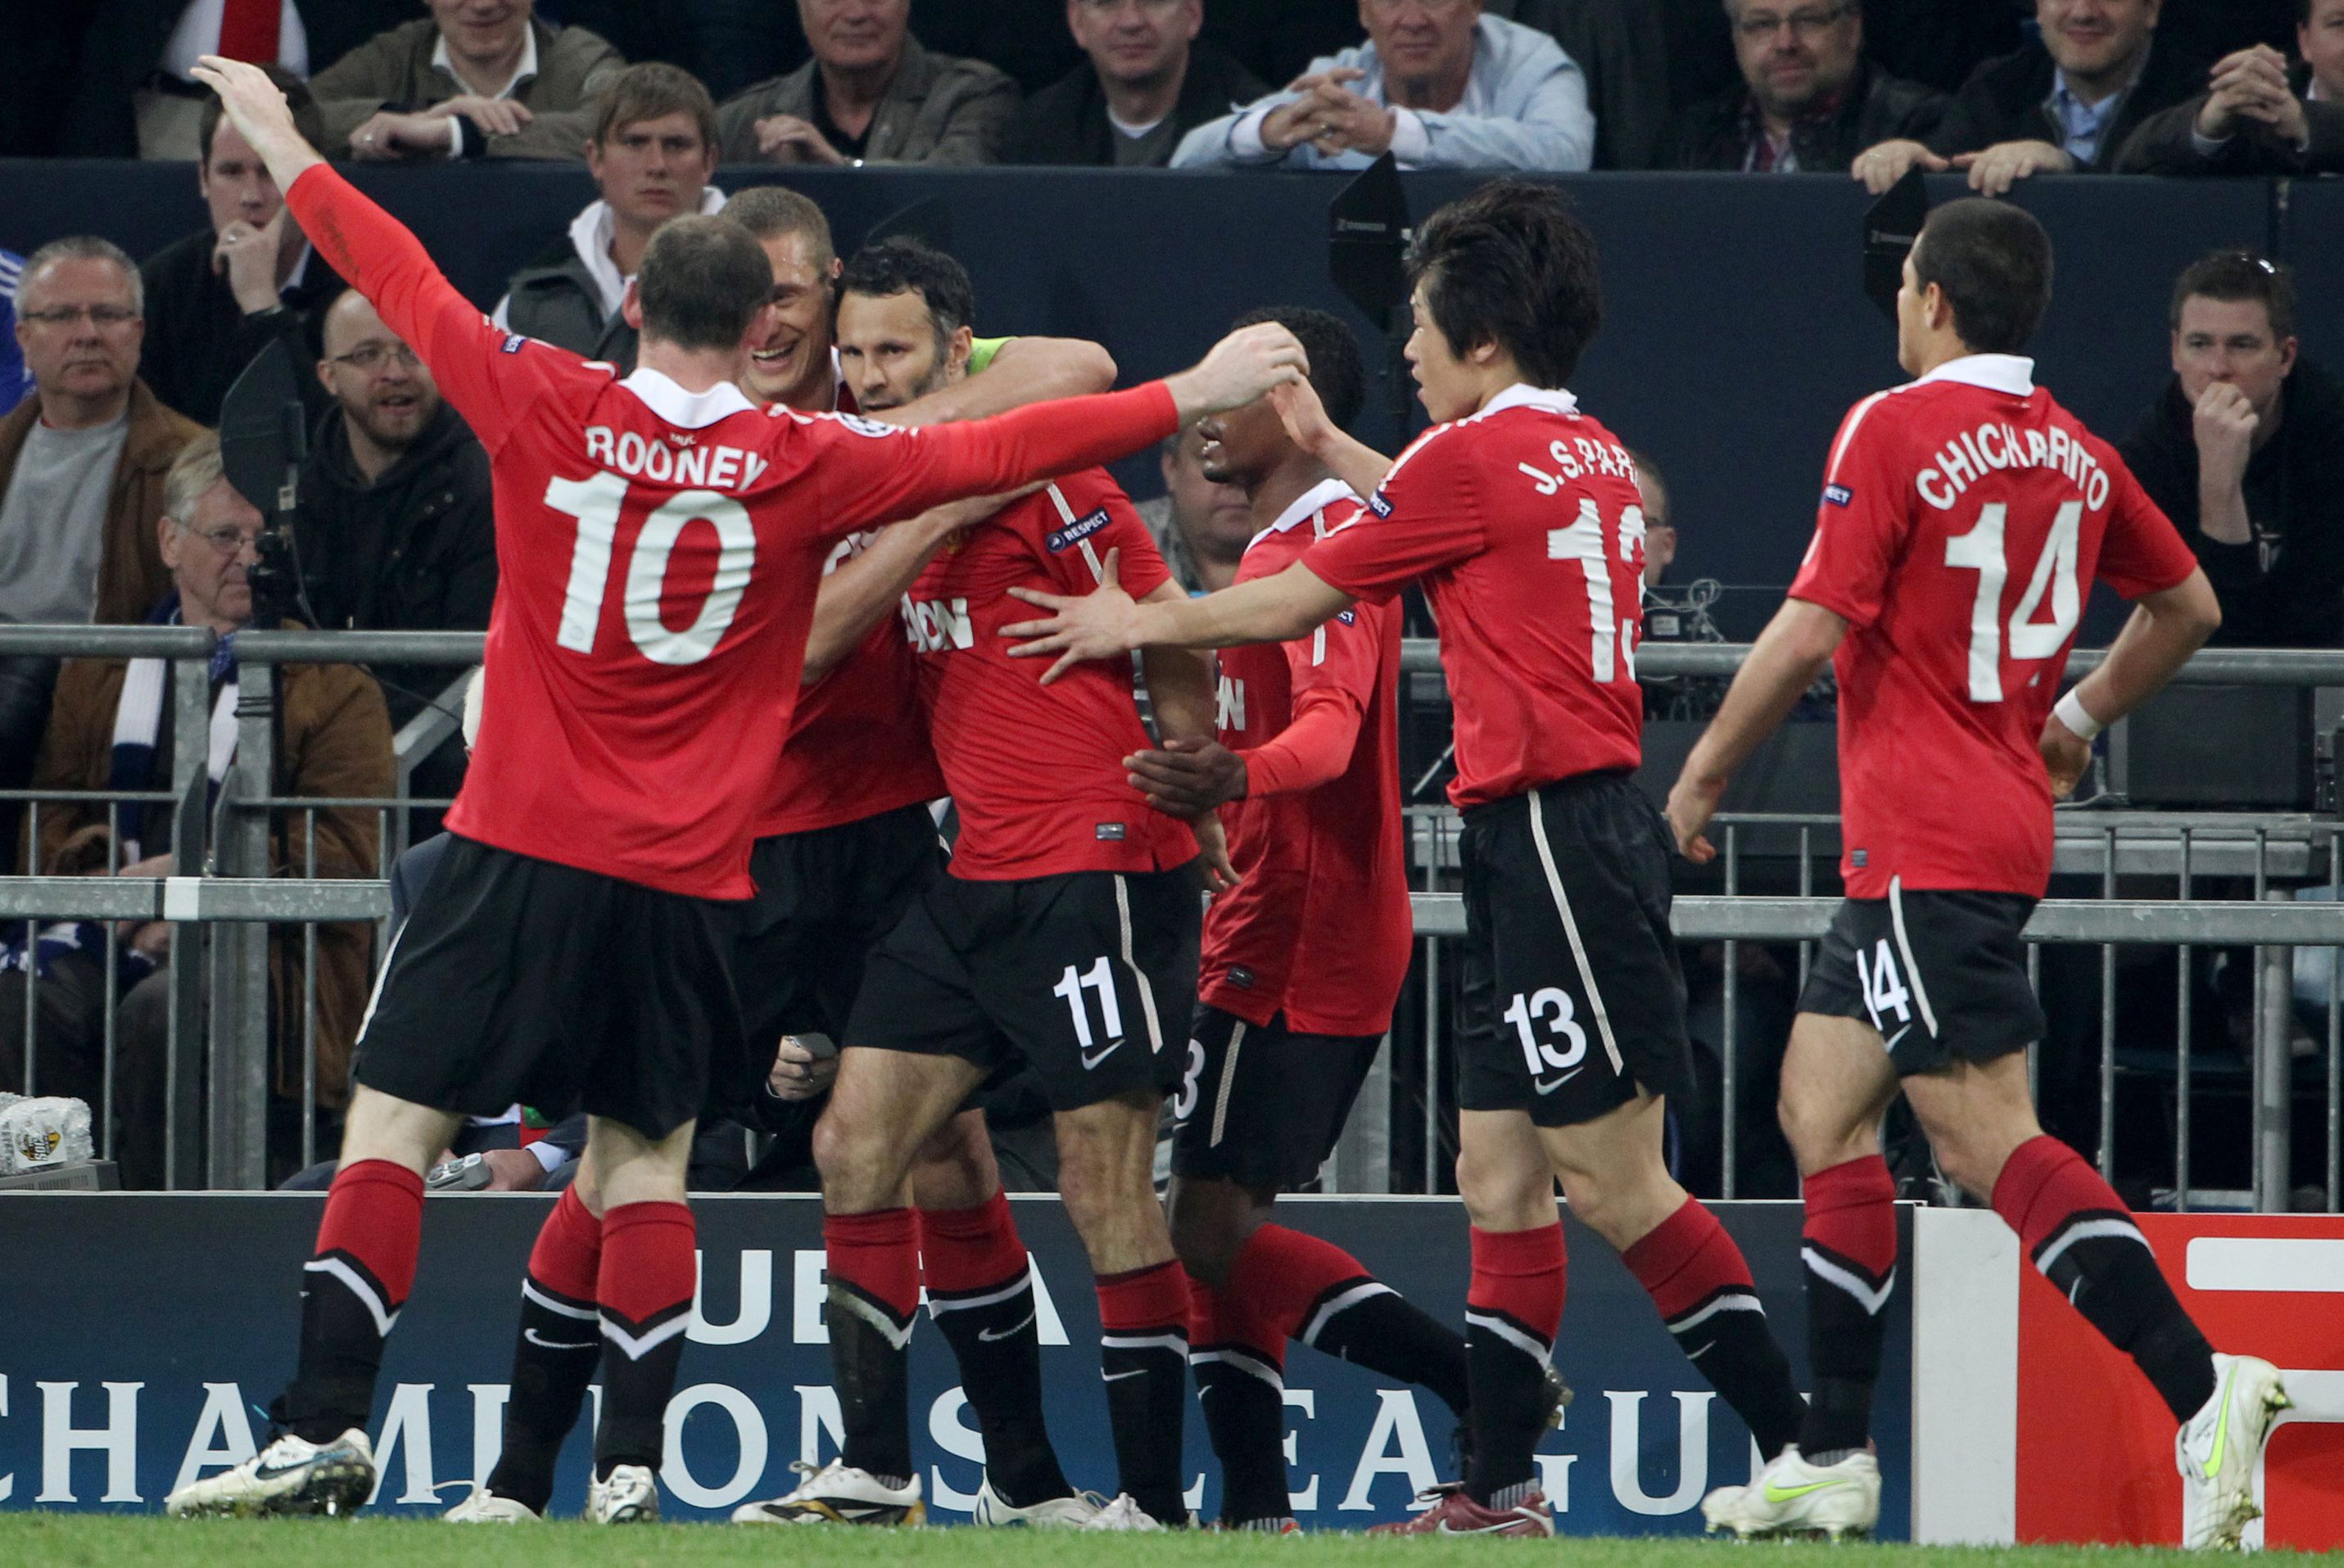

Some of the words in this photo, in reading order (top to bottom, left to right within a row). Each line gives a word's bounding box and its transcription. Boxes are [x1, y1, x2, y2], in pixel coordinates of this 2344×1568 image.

[585, 425, 769, 492] ROONEY
[1518, 437, 1641, 495] J.S.PAR
[543, 470, 757, 666] 10
[1063, 511, 1109, 541] RESPECT
[1944, 500, 2080, 703] 14
[1053, 956, 1123, 1049] 11
[1856, 938, 1910, 1032] 14
[1504, 987, 1587, 1076] 13
